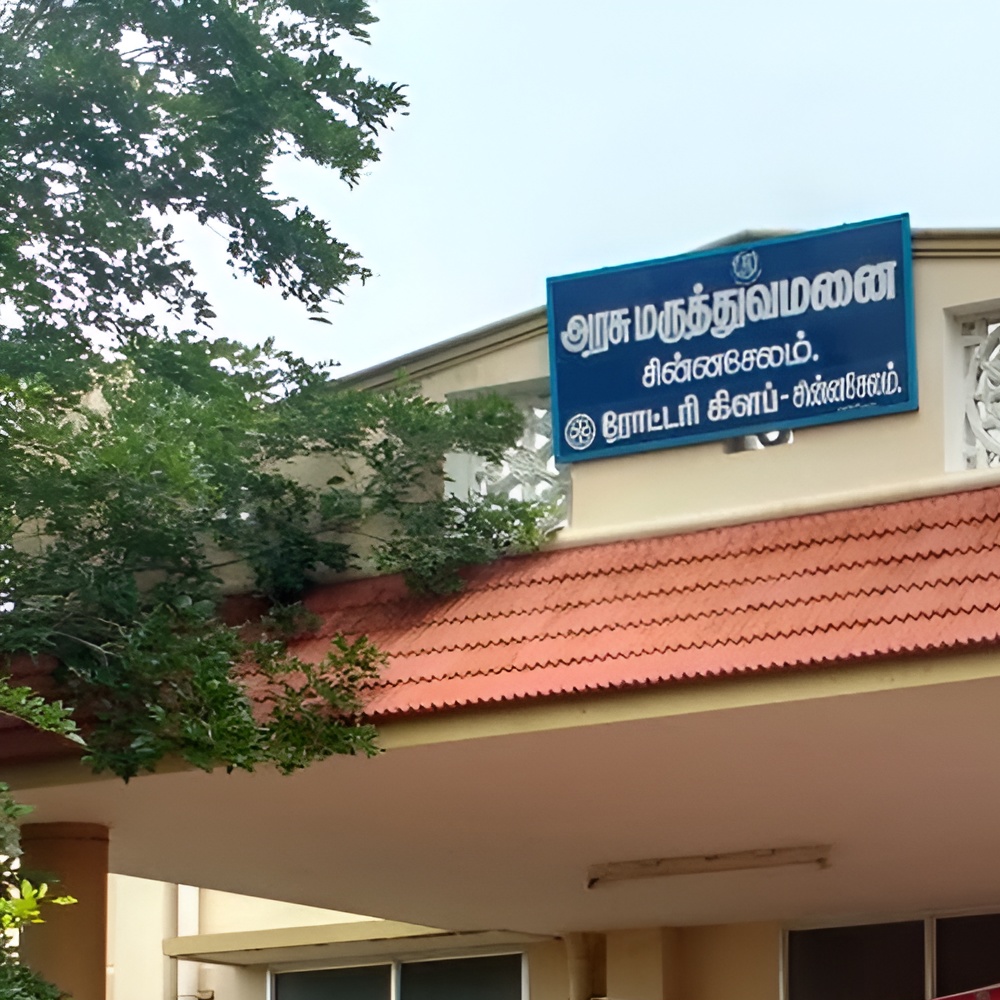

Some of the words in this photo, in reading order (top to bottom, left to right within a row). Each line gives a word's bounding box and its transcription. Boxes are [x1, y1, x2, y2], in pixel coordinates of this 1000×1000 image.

[560, 308, 632, 359] அரசு
[634, 261, 897, 344] மருத்துவமனை
[641, 331, 820, 388] சின்னசேலம்.
[602, 394, 700, 444] ரோட்டரி
